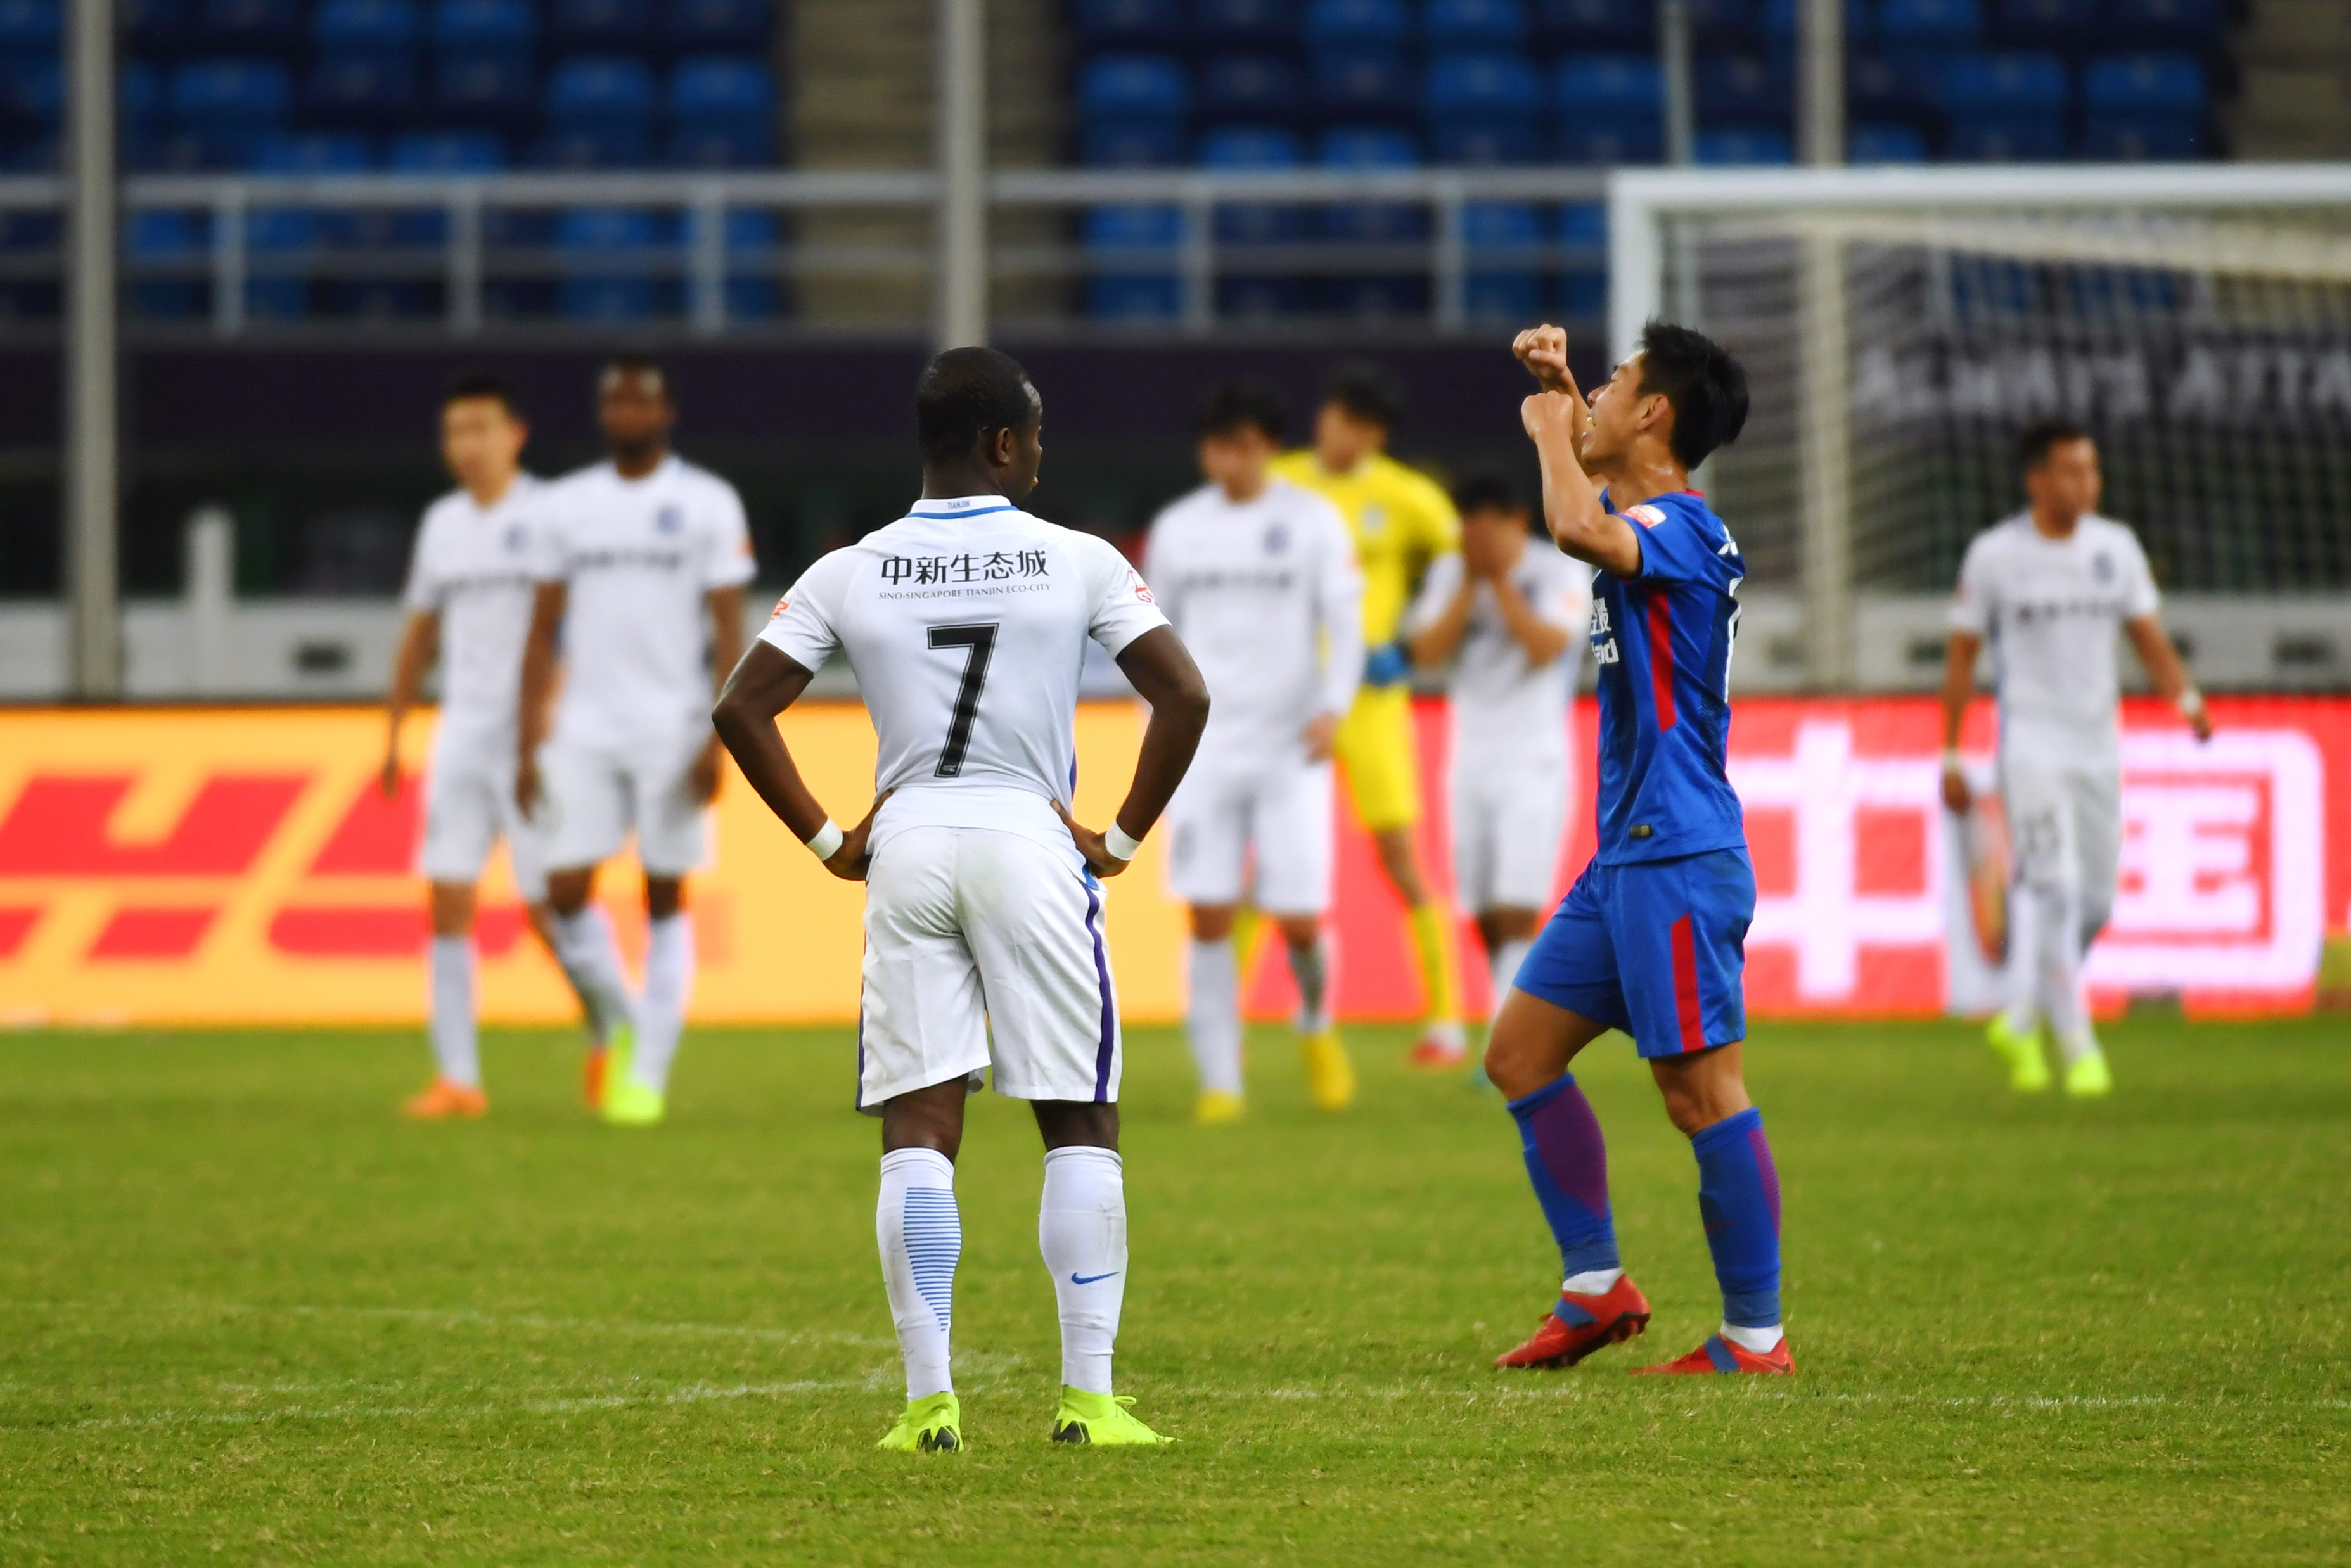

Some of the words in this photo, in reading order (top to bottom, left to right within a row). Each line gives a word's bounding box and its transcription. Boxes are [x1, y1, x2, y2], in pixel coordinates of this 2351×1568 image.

[947, 500, 970, 509] TIANJIN
[881, 550, 1050, 585] 中新生态城
[879, 590, 962, 600] SINO-SINGAPORE
[966, 587, 1003, 597] TIANJIN
[1006, 583, 1051, 594] ECO-CITY
[927, 623, 999, 777] 7
